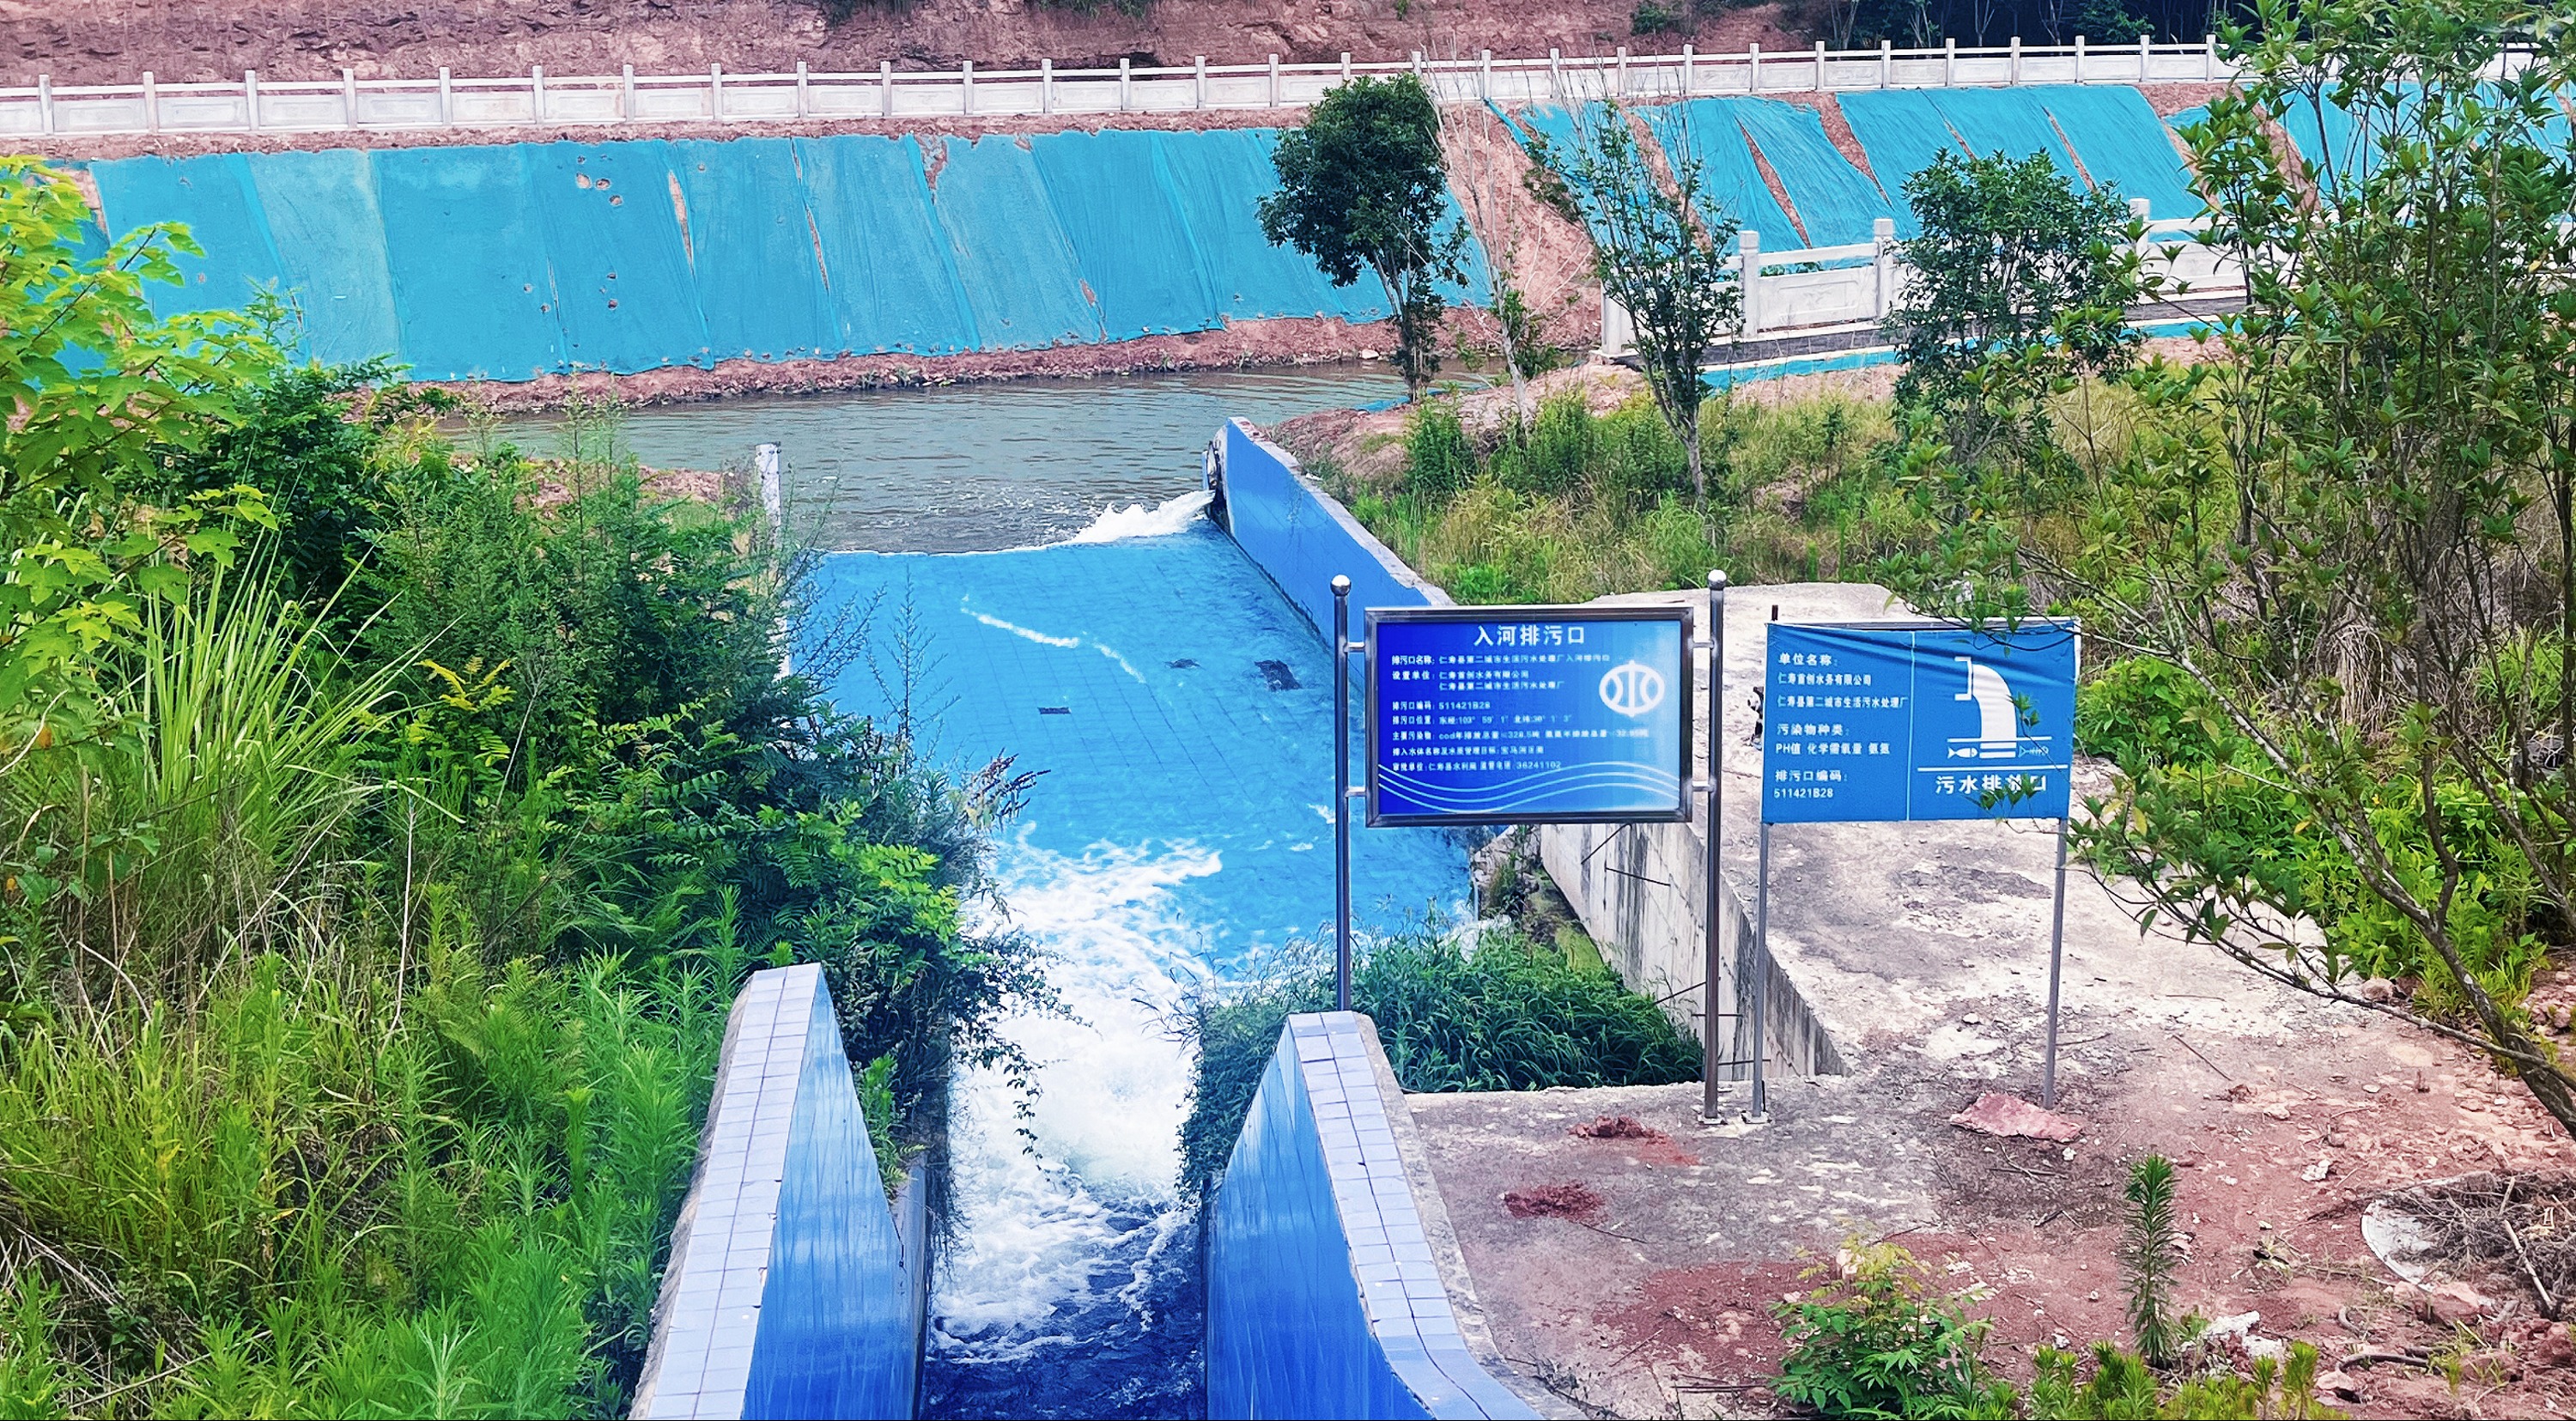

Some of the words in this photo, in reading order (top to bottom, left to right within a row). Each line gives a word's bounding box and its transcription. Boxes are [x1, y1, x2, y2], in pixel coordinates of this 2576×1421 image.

[1473, 624, 1585, 647] 入河排污口
[1777, 651, 1839, 667] 单位名称：
[1438, 670, 1529, 682] 仁寿首创水务有限公司
[1777, 671, 1872, 687] 仁寿首创水务有限公司
[1438, 681, 1565, 692] 仁寿县第二城市生活污水处理厂
[1438, 701, 1491, 711] 511421B28
[1777, 694, 1909, 709] 仁寿县第二城市生活污水处理厂
[1776, 723, 1850, 737] 污染物种类：
[1775, 742, 1801, 756] PH值
[1807, 742, 1863, 756] 化学需氧量
[1868, 742, 1891, 756] 氨氮
[1775, 768, 1848, 783] 排污口编码：
[1773, 786, 1834, 799] 511421B28
